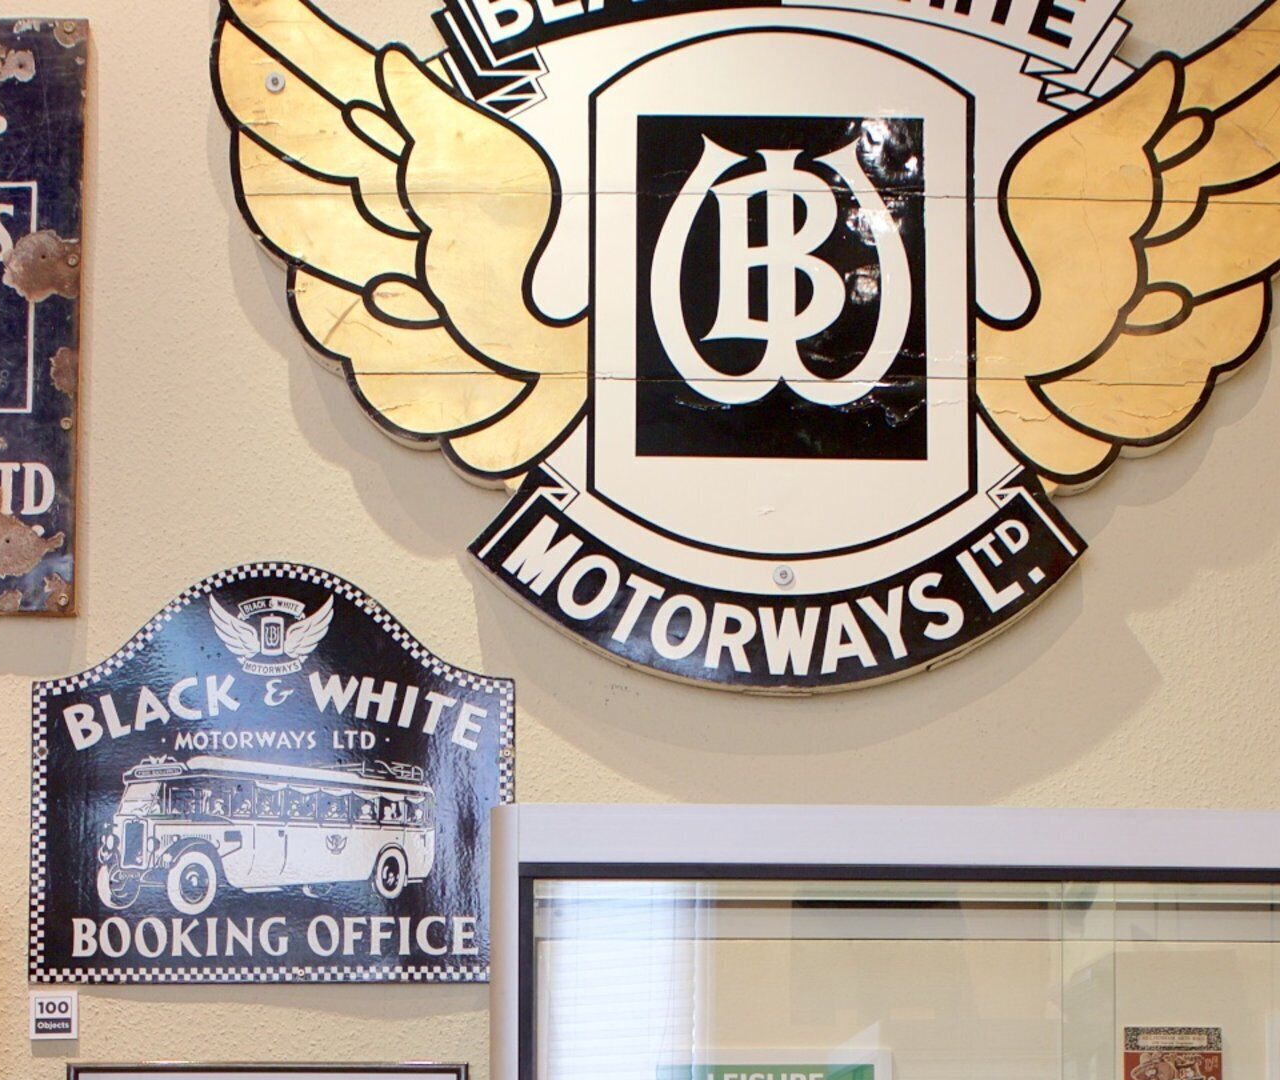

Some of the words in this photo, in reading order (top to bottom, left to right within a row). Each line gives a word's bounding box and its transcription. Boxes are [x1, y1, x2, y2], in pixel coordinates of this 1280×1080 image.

[503, 518, 965, 676] MOTORWAYS
[244, 661, 300, 674] MOTORWAYS
[62, 673, 241, 752] BLACK
[264, 680, 293, 707] &
[309, 672, 488, 752] WHITE
[174, 729, 317, 752] MOTORWAYS
[332, 730, 377, 750] LTD
[71, 916, 288, 958] BOOKING
[307, 915, 479, 957] OFFICE
[37, 1001, 69, 1016] 100
[36, 1020, 70, 1032] Objects
